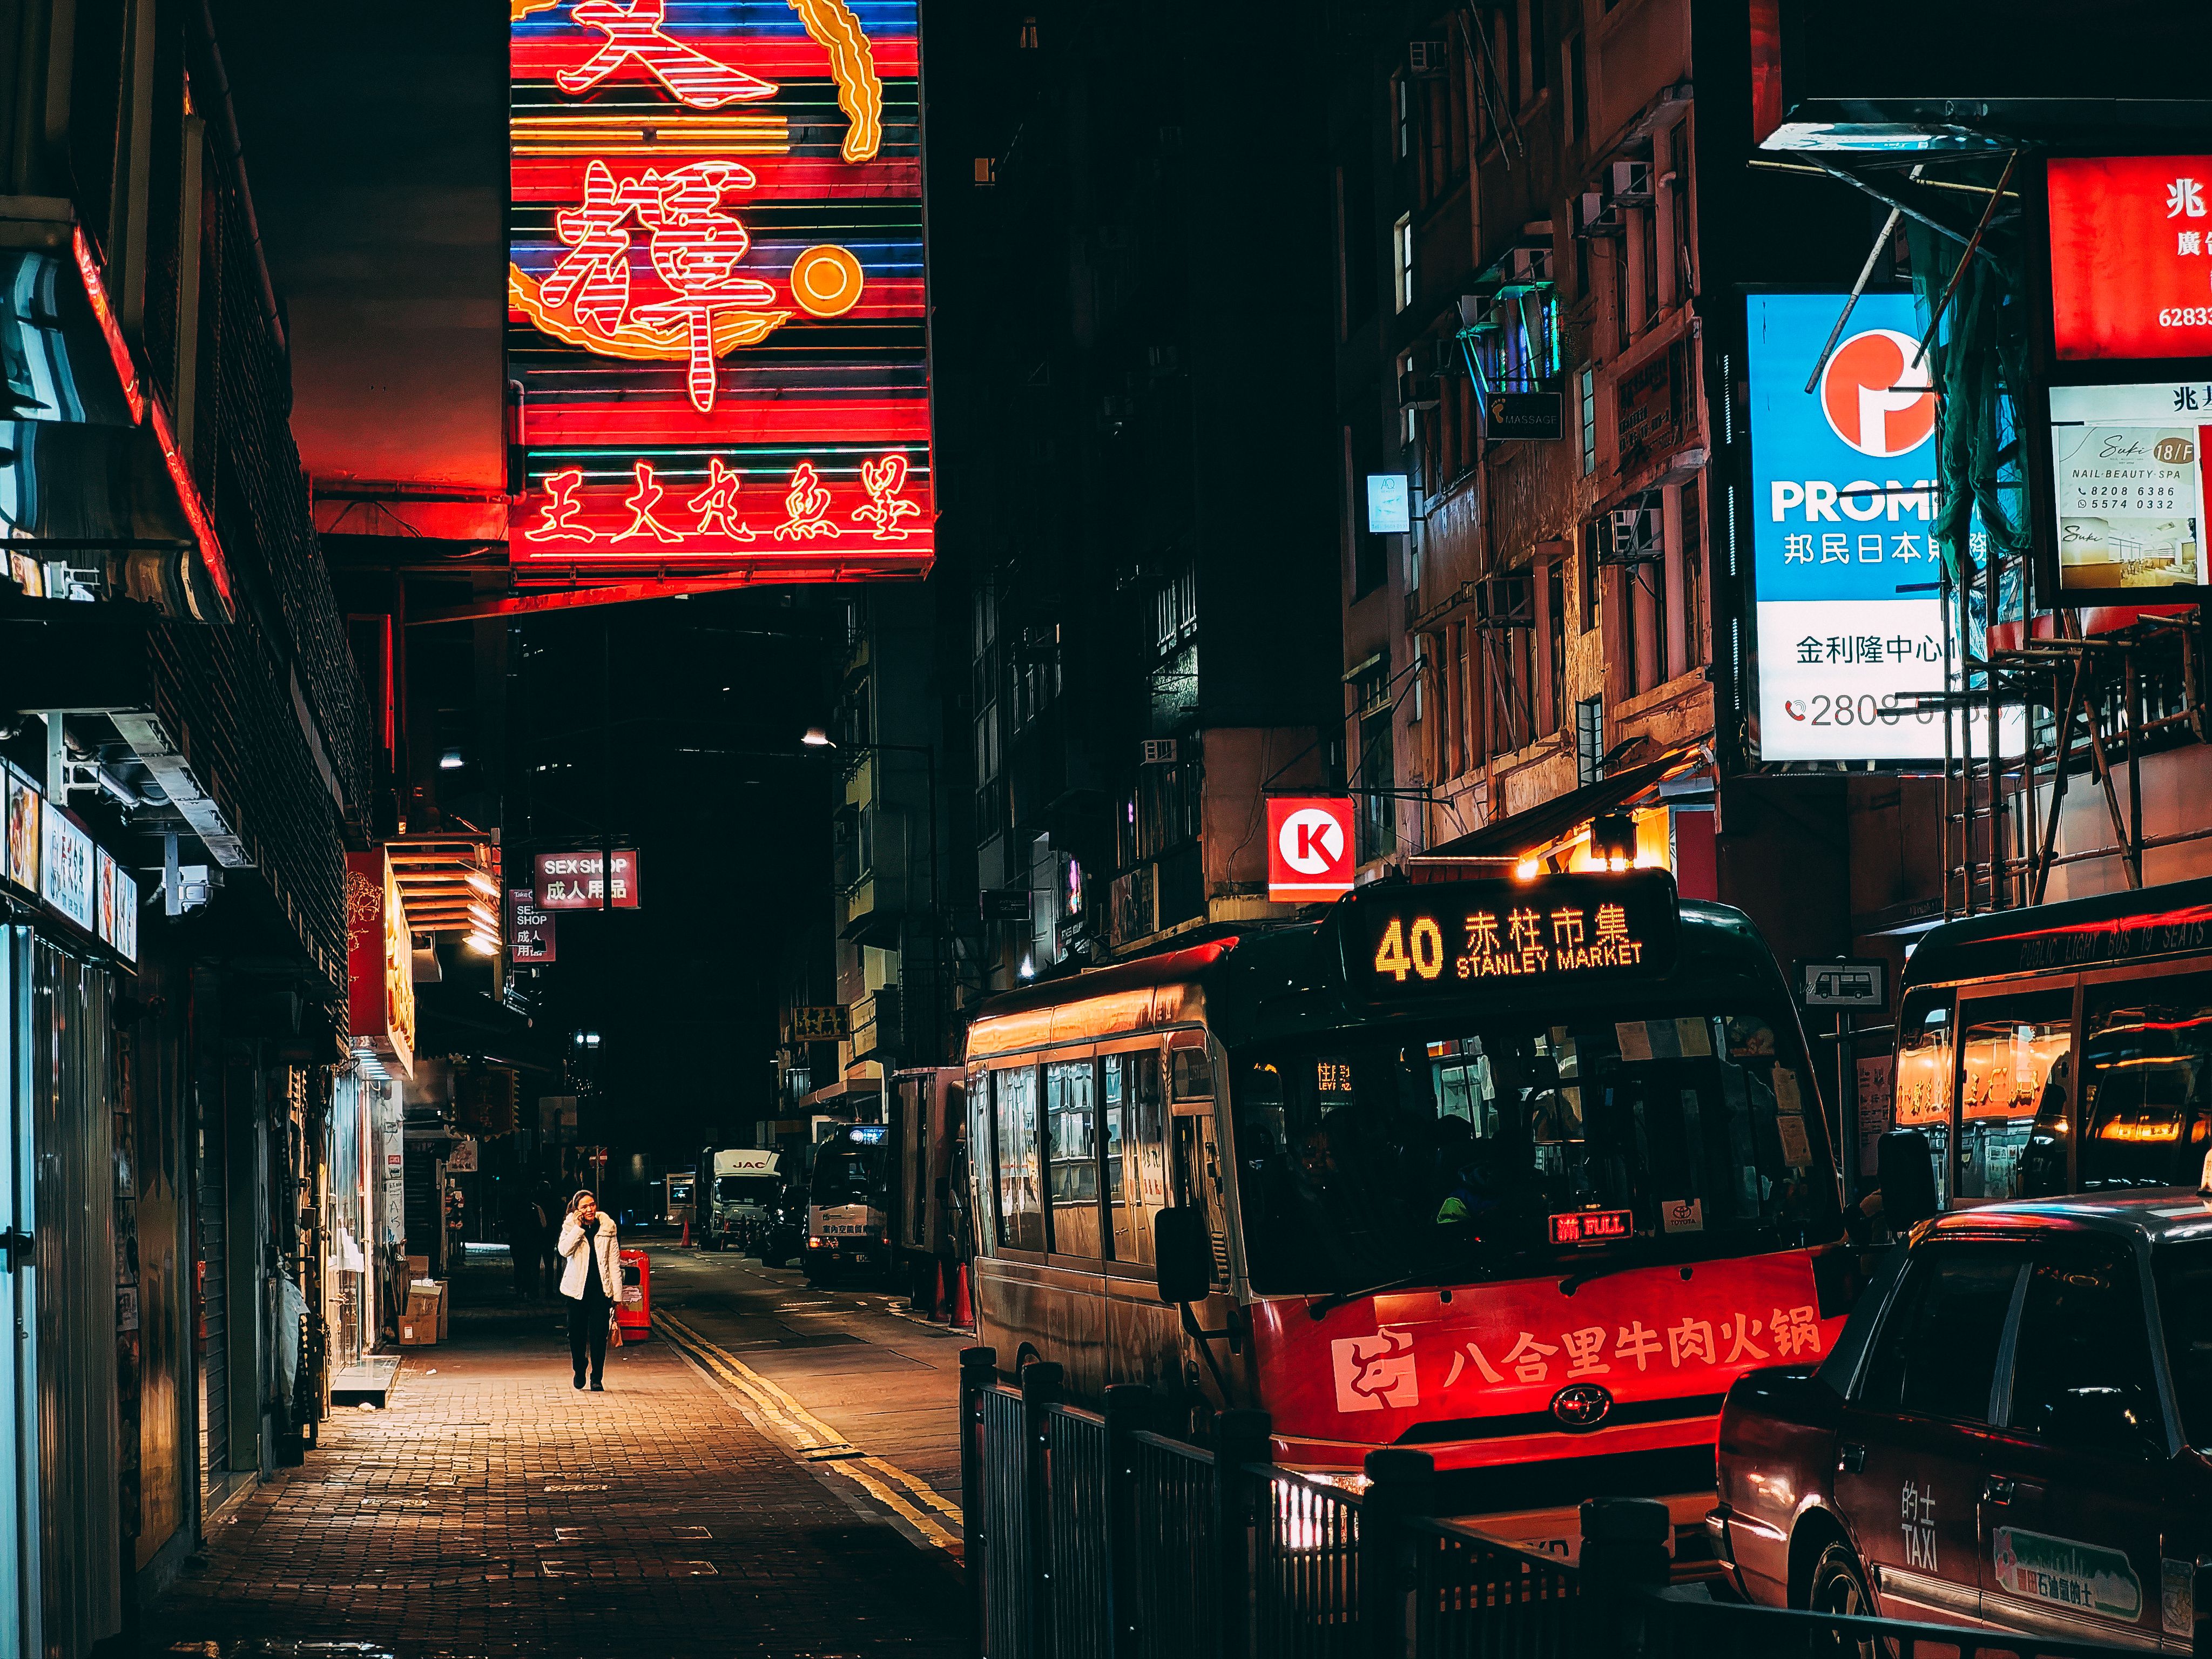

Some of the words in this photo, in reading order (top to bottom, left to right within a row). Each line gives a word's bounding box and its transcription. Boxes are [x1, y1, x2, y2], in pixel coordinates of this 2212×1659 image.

[1505, 415, 1557, 424] MASSAGE
[2099, 435, 2153, 458] Suki
[2157, 443, 2194, 461] 18/F
[2091, 487, 2128, 496] 8208
[2137, 487, 2174, 496] 6386
[2091, 499, 2127, 509] 5574
[2136, 500, 2174, 509] 0332
[1811, 694, 1900, 726] 2808
[1297, 823, 1339, 870] K
[544, 859, 578, 874] SEX
[580, 858, 627, 874] SHP
[546, 880, 627, 900] 成人用品
[517, 915, 547, 925] SHOP
[1464, 903, 1630, 956] 赤柱市集
[1375, 916, 1444, 982] 40
[2019, 937, 2058, 970] PUBLIC
[2065, 930, 2100, 963] LIGHT
[2107, 929, 2132, 957] BUS
[2141, 925, 2154, 953] 19
[2163, 920, 2206, 949] SEATS
[1456, 950, 1549, 979] STANLEY
[1557, 942, 1643, 970] MARKET
[1584, 1216, 1625, 1235] FULL
[1670, 1218, 1696, 1226] TOYOTA
[1442, 1305, 1822, 1388] 八合里牛肉火锅
[1901, 1480, 1936, 1527] 的士
[1901, 1523, 1938, 1573] TAXI
